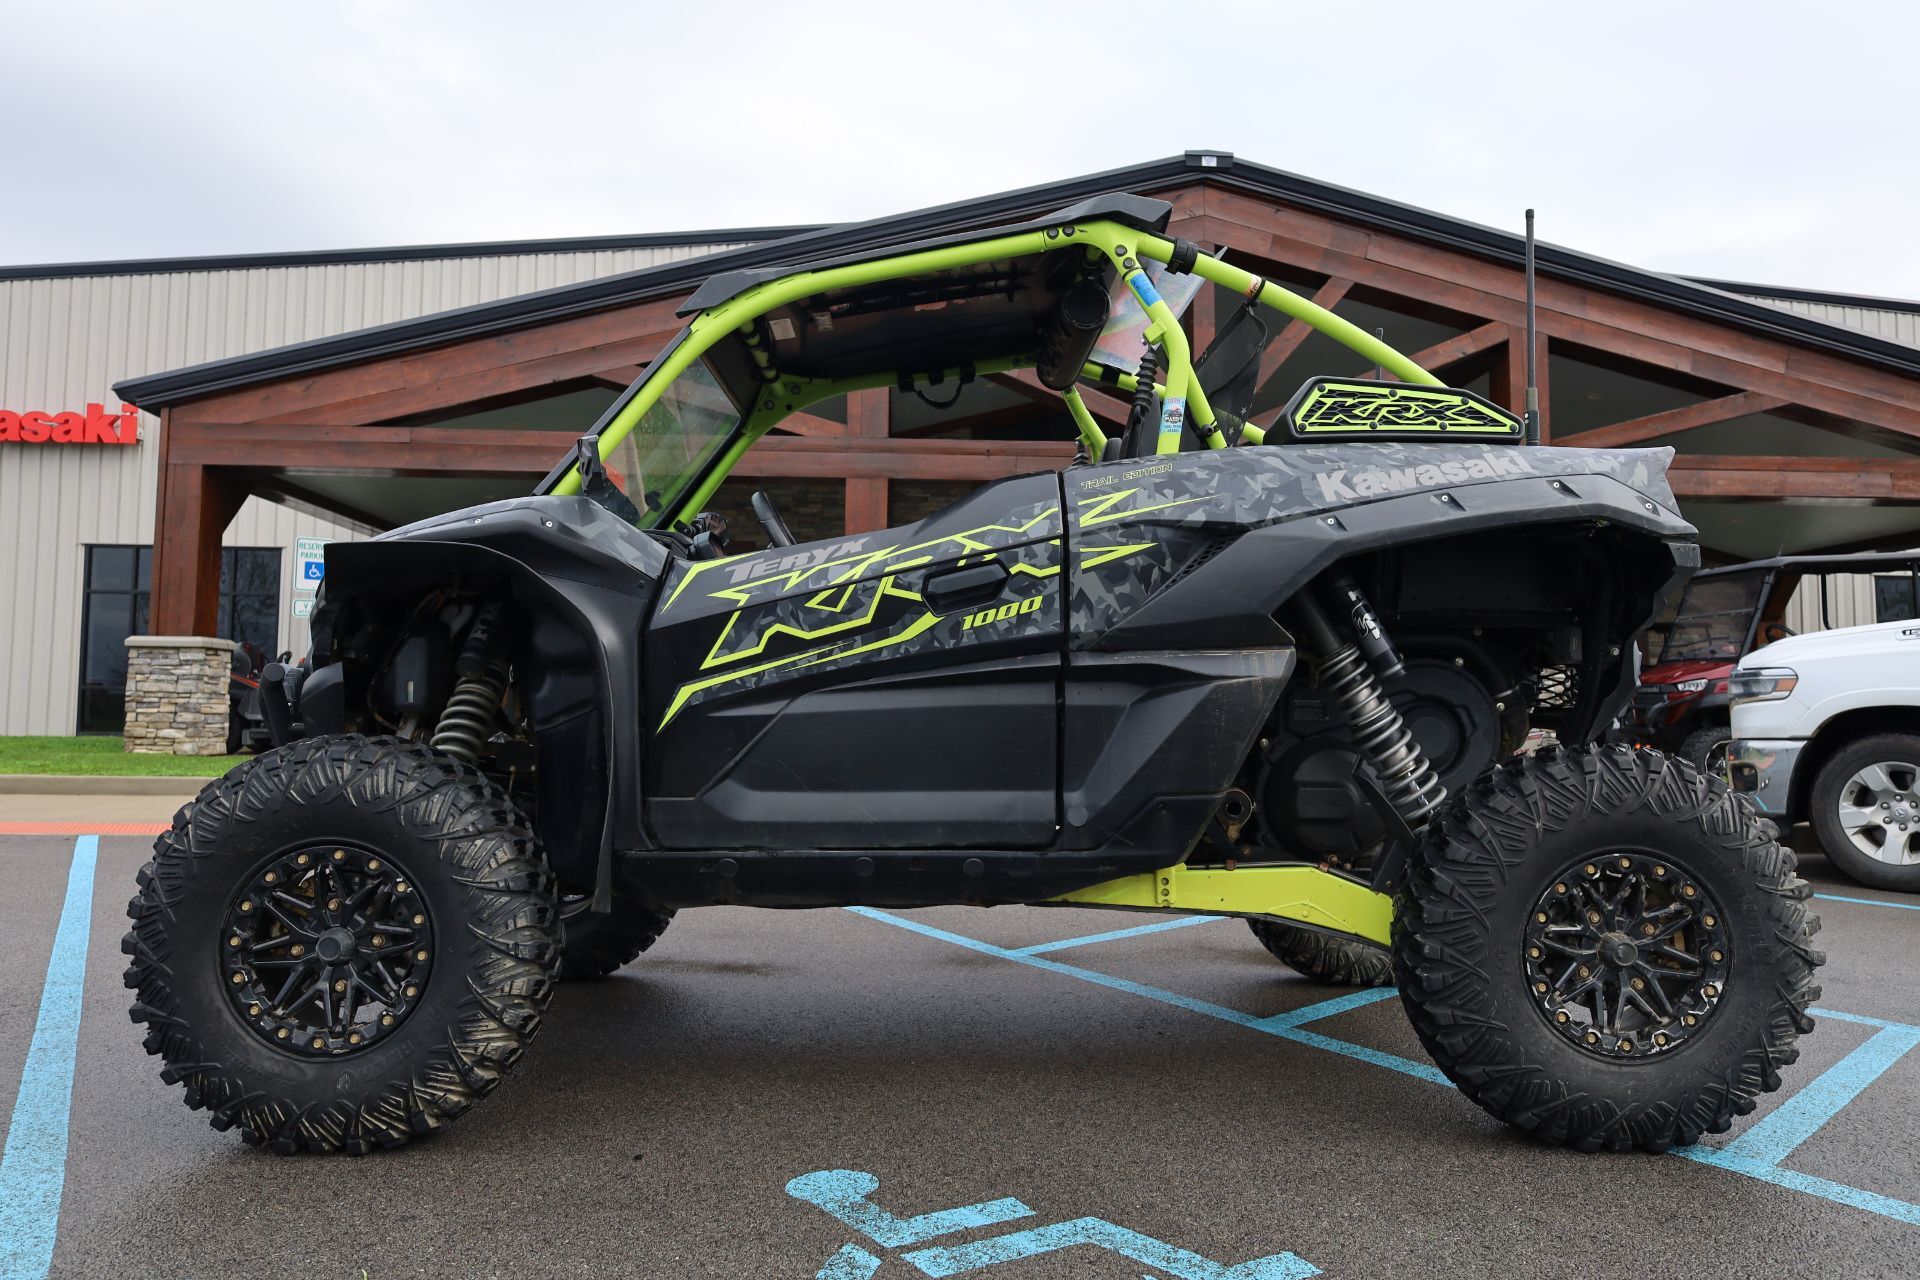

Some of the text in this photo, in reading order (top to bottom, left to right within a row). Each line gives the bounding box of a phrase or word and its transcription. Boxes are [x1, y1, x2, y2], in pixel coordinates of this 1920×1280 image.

[1081, 463, 1173, 490] TRAIL EDITION
[1316, 449, 1533, 502] Kawasaki
[725, 536, 871, 584] TERYX
[962, 595, 1044, 631] 1000
